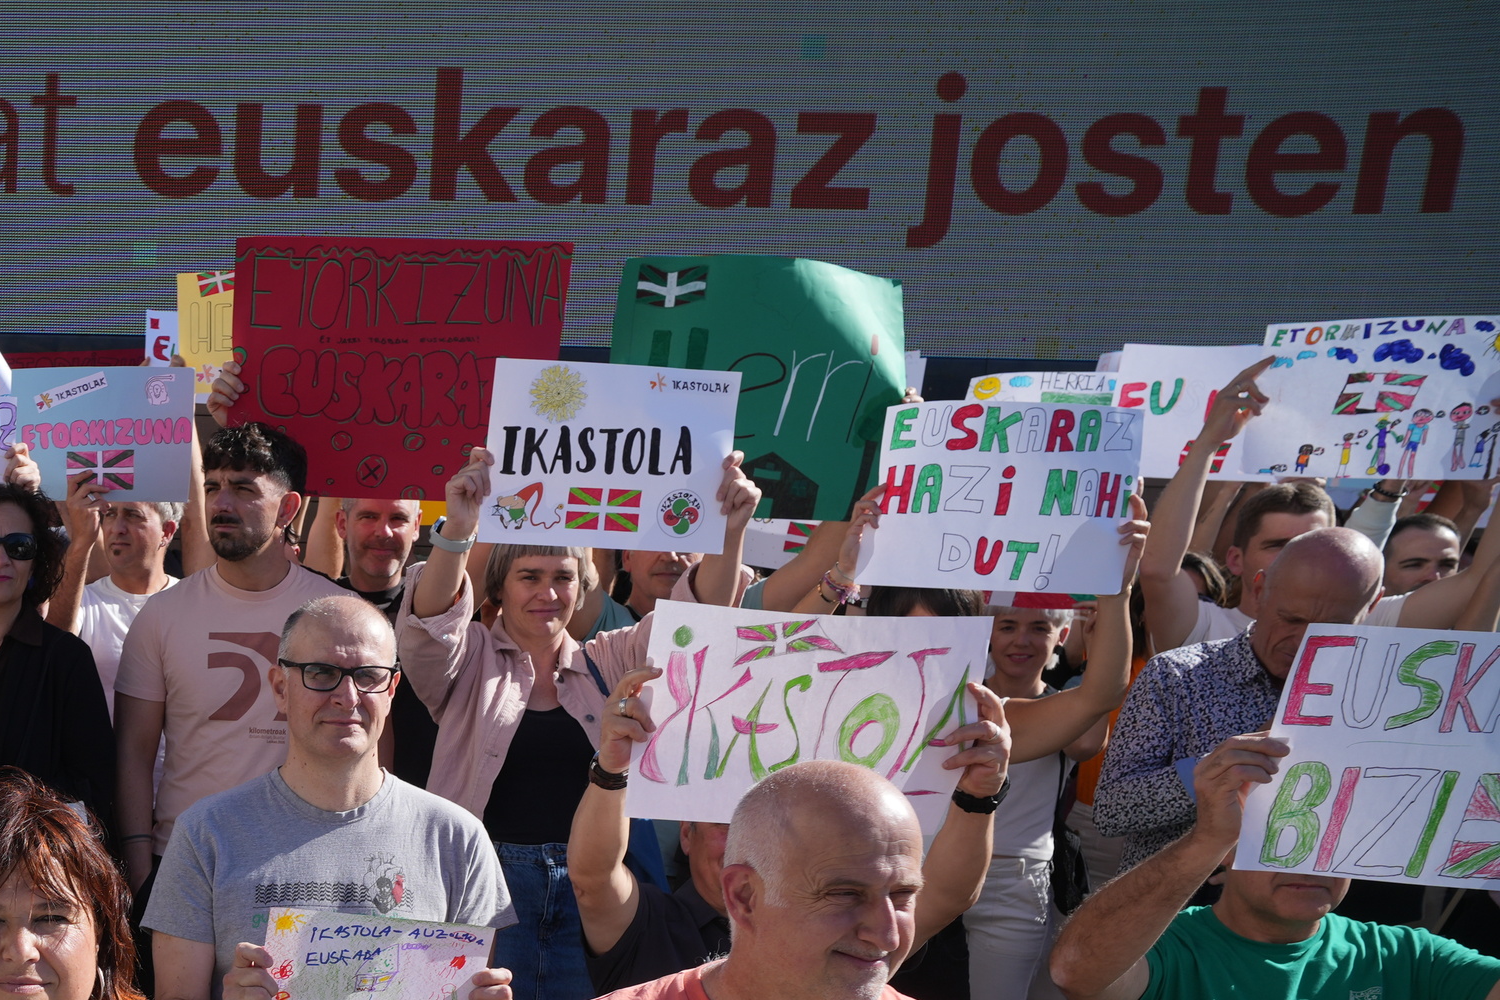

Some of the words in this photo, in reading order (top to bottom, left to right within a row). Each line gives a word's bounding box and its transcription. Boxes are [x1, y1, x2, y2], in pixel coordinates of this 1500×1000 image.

[133, 67, 877, 208] euskaraz
[906, 71, 1465, 249] josten
[250, 253, 564, 330] ETORKIZUNA
[1272, 318, 1466, 347] ETORKIZUNA
[55, 376, 107, 401] IKASTOLAK
[672, 380, 730, 393] IKASTOLAK
[1040, 371, 1106, 391] HERRIA
[21, 416, 192, 451] ETORKIZUNA
[500, 424, 692, 476] IKASTOLA
[890, 403, 1136, 453] EUSKARAZ
[938, 533, 1061, 590] DUT!
[1282, 636, 1500, 734] EUSK
[249, 726, 287, 736] kilometroak
[1259, 761, 1460, 878] BIZI
